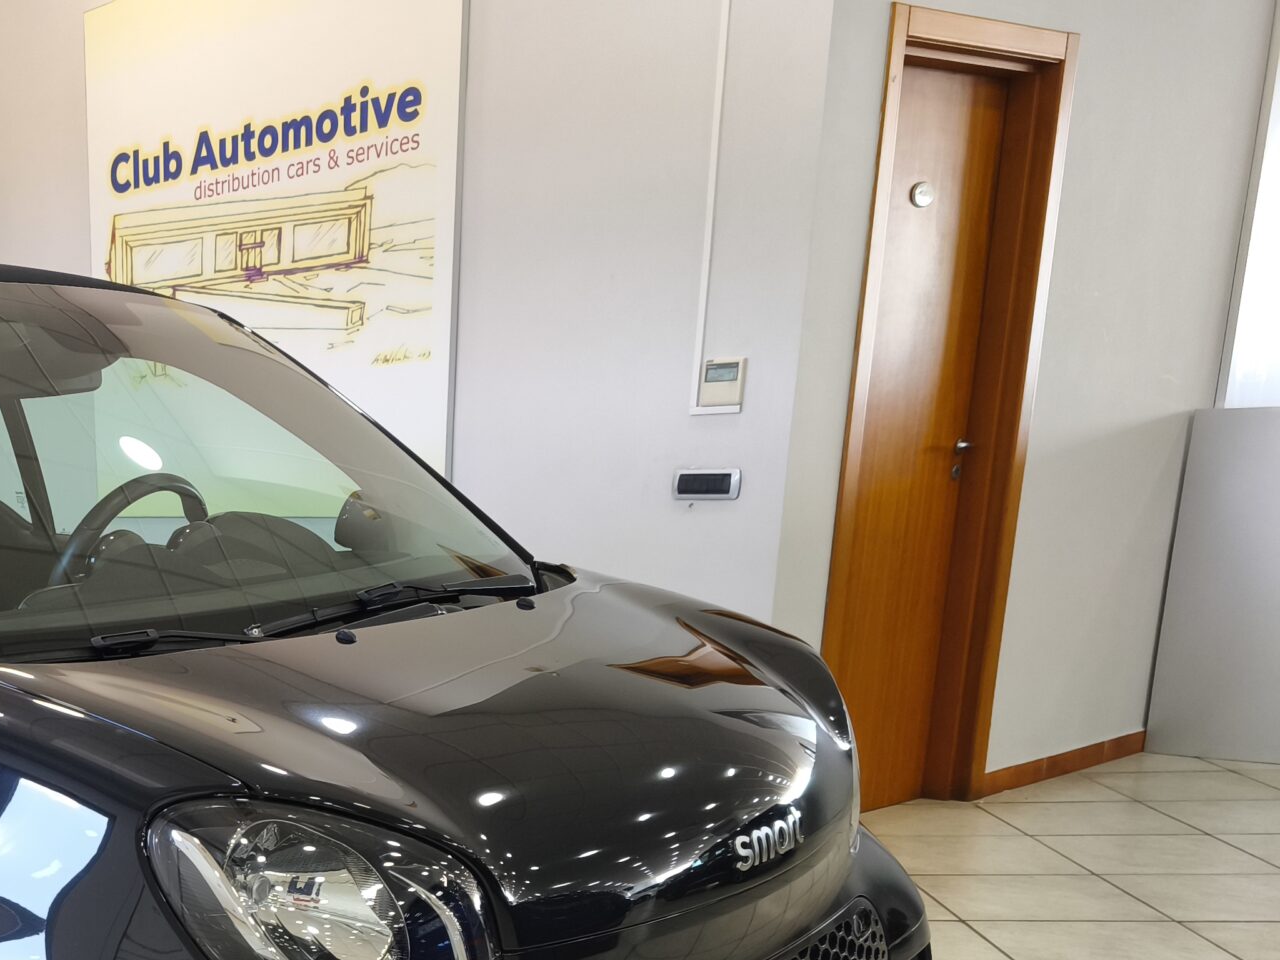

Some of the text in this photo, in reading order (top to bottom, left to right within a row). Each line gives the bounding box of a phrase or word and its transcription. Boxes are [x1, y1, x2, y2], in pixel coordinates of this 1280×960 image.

[110, 85, 423, 194] Club Automotive
[194, 133, 420, 201] distribution cars & services
[735, 806, 804, 872] smart
